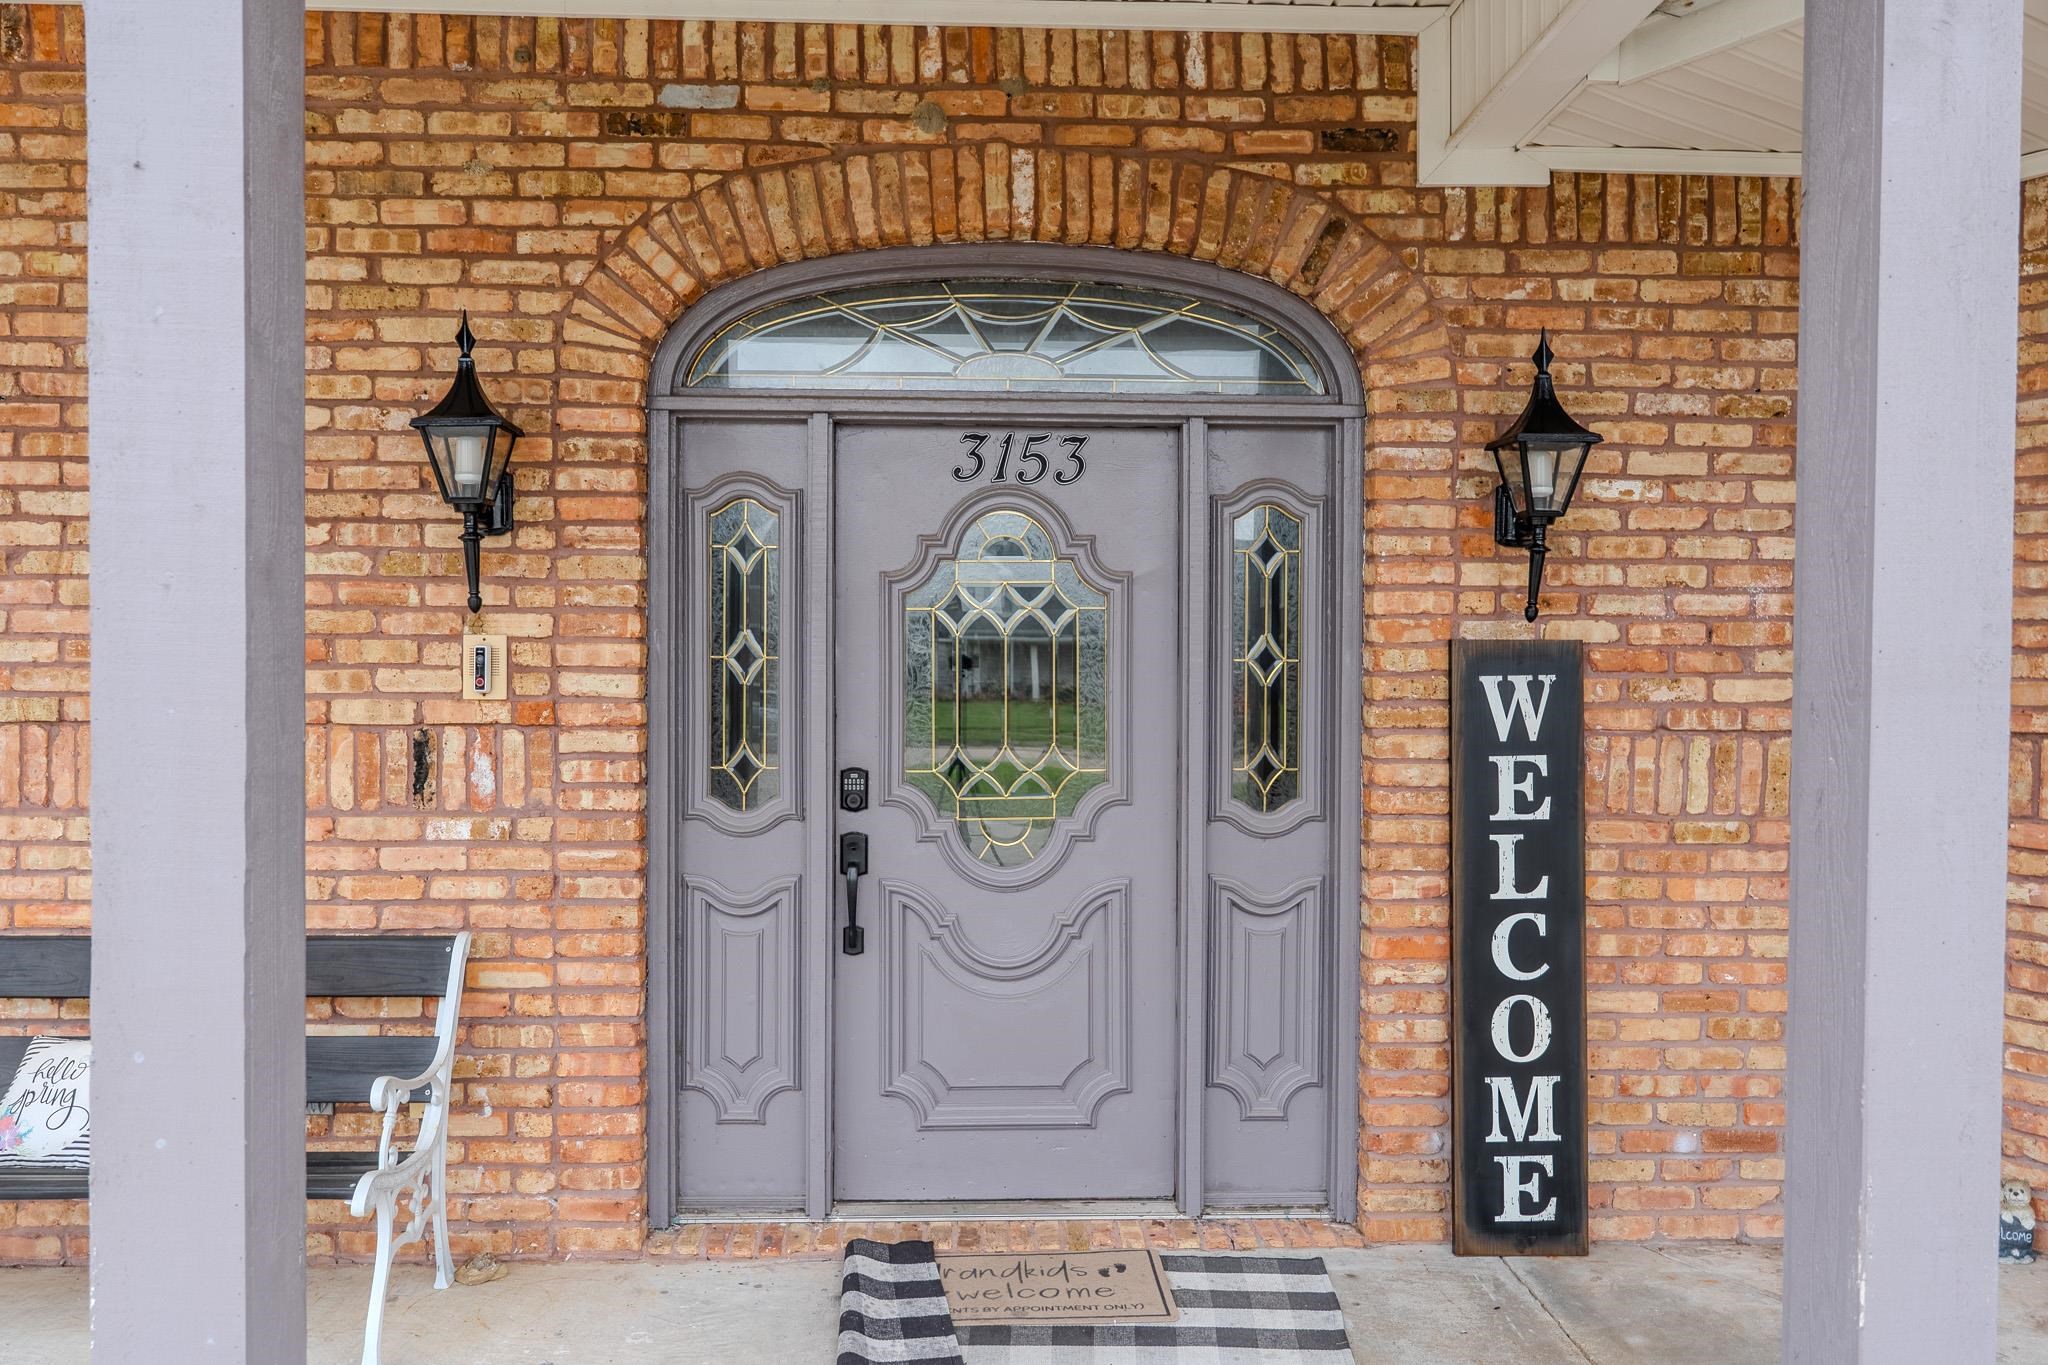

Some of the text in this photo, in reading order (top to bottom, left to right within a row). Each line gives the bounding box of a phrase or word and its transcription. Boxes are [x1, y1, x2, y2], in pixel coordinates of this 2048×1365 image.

[951, 431, 1091, 486] 3153
[1478, 673, 1563, 1223] WELCOME
[30, 1056, 89, 1084] hello
[8, 1081, 90, 1131] spring
[2000, 1227, 2033, 1243] lcome
[956, 1282, 1116, 1301] welcome
[1003, 1303, 1100, 1313] APPOINTMENT
[1104, 1302, 1145, 1311] ONLY)
